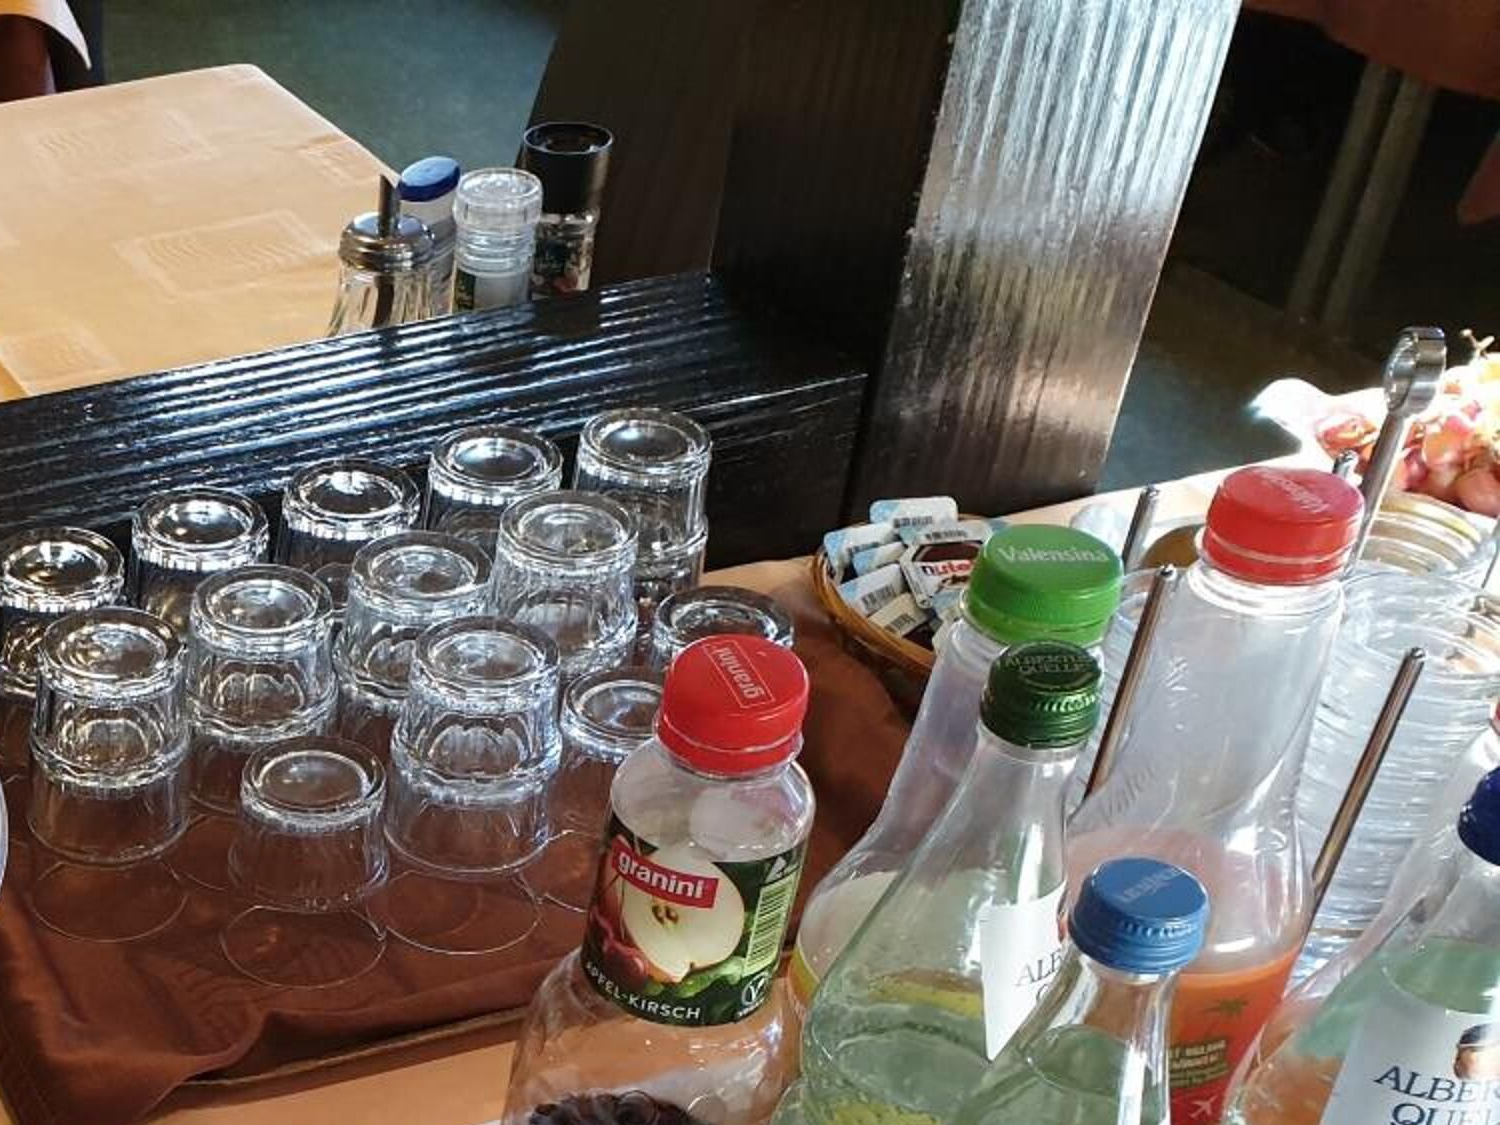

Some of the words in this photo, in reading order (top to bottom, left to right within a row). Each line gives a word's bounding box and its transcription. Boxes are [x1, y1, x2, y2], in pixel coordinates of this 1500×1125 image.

[998, 545, 1110, 564] Valensina
[713, 647, 765, 699] granini
[618, 852, 704, 899] granini
